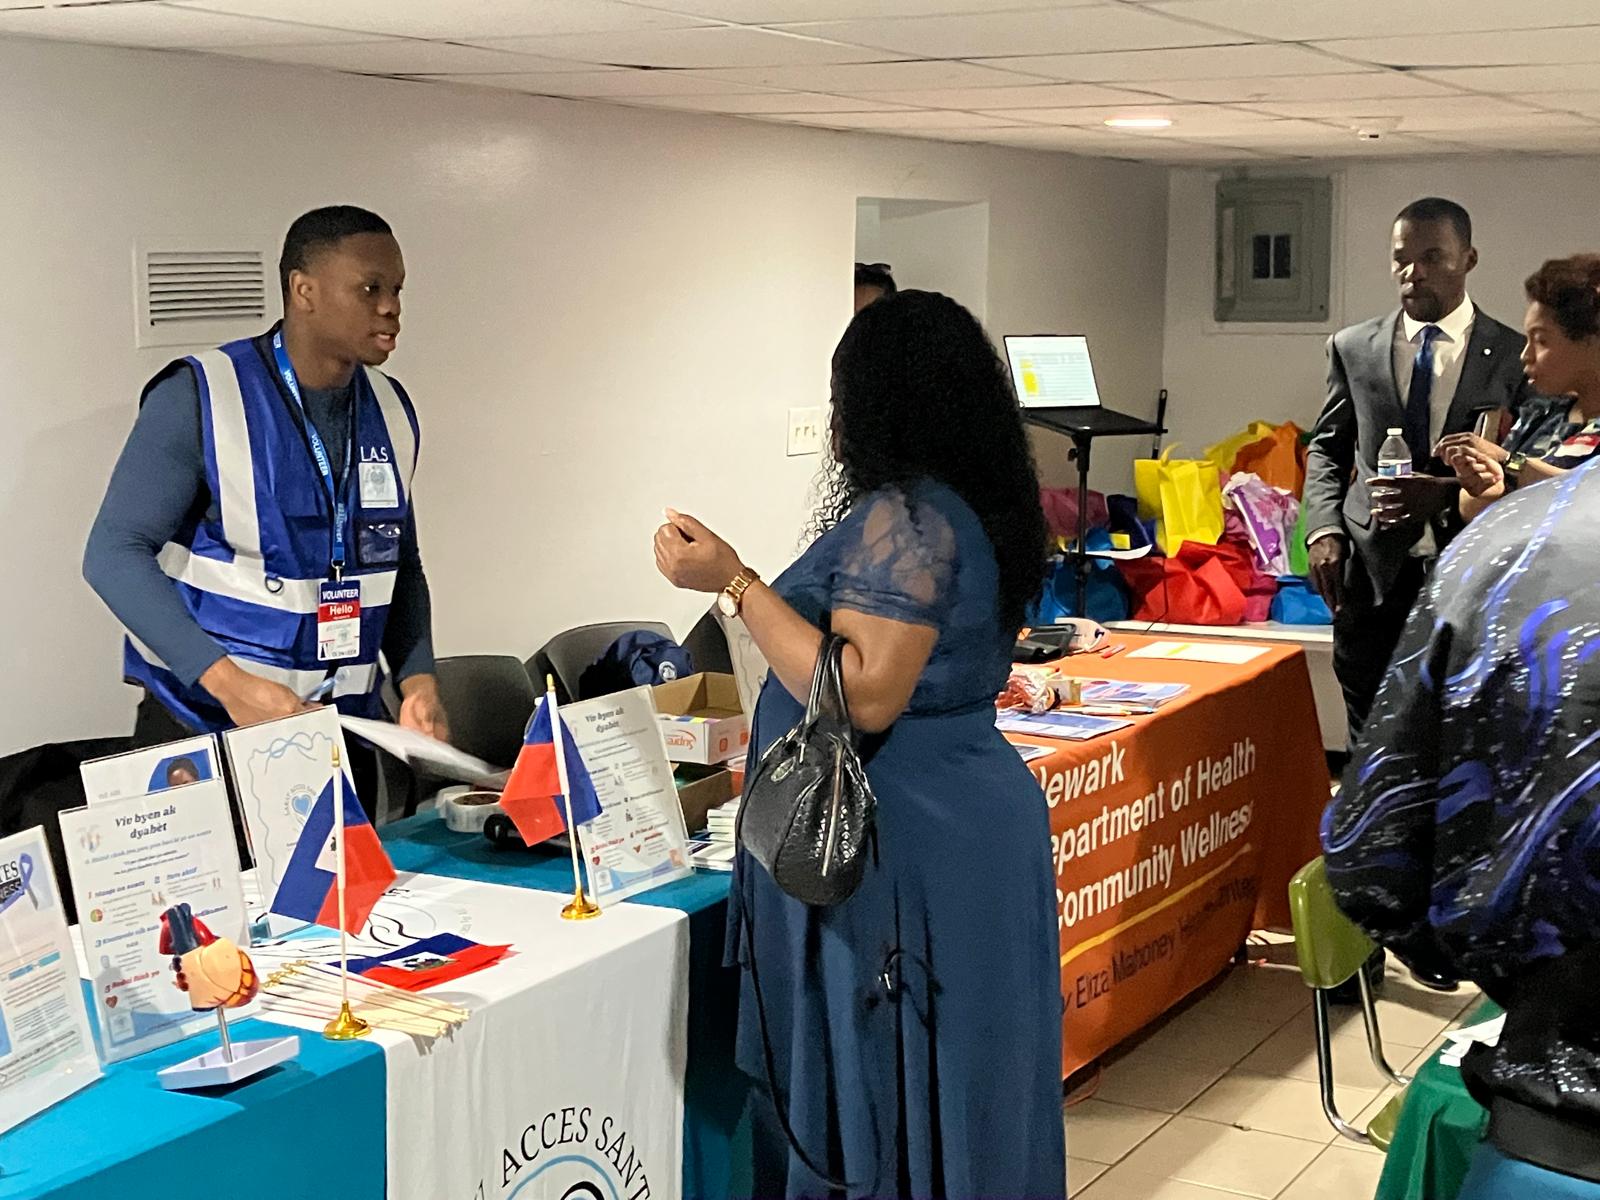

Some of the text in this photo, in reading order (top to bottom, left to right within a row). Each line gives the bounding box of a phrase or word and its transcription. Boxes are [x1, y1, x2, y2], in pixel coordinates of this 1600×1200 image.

[360, 446, 389, 463] LAS
[322, 588, 359, 600] VOLUNTEER
[329, 604, 354, 616] Hello
[115, 804, 177, 828] Viv byen ak
[1050, 736, 1256, 876] epartment of Health
[1180, 800, 1254, 867] Wellnes
[501, 1106, 592, 1188] ACCES
